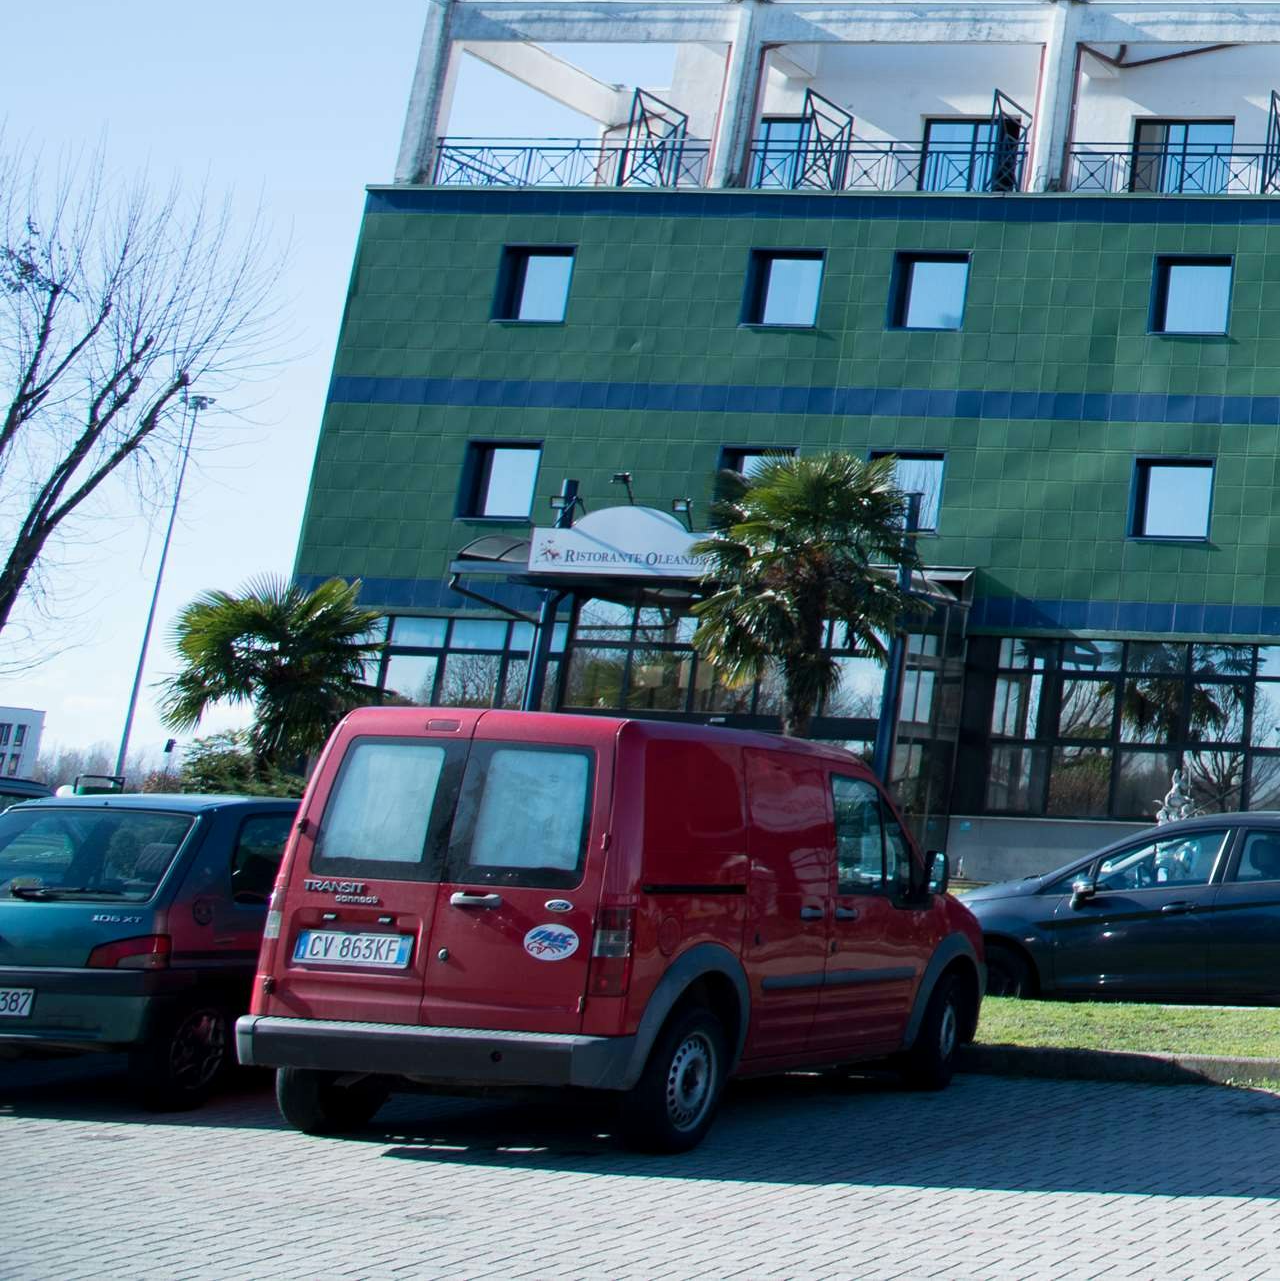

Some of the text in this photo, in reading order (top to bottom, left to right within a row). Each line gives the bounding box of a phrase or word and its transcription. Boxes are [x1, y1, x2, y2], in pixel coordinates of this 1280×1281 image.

[565, 549, 642, 564] RISTORANTE
[303, 879, 365, 894] TRANSIT
[335, 894, 378, 904] connect
[309, 935, 399, 961] CV 863KF
[0, 991, 31, 1014] 387
